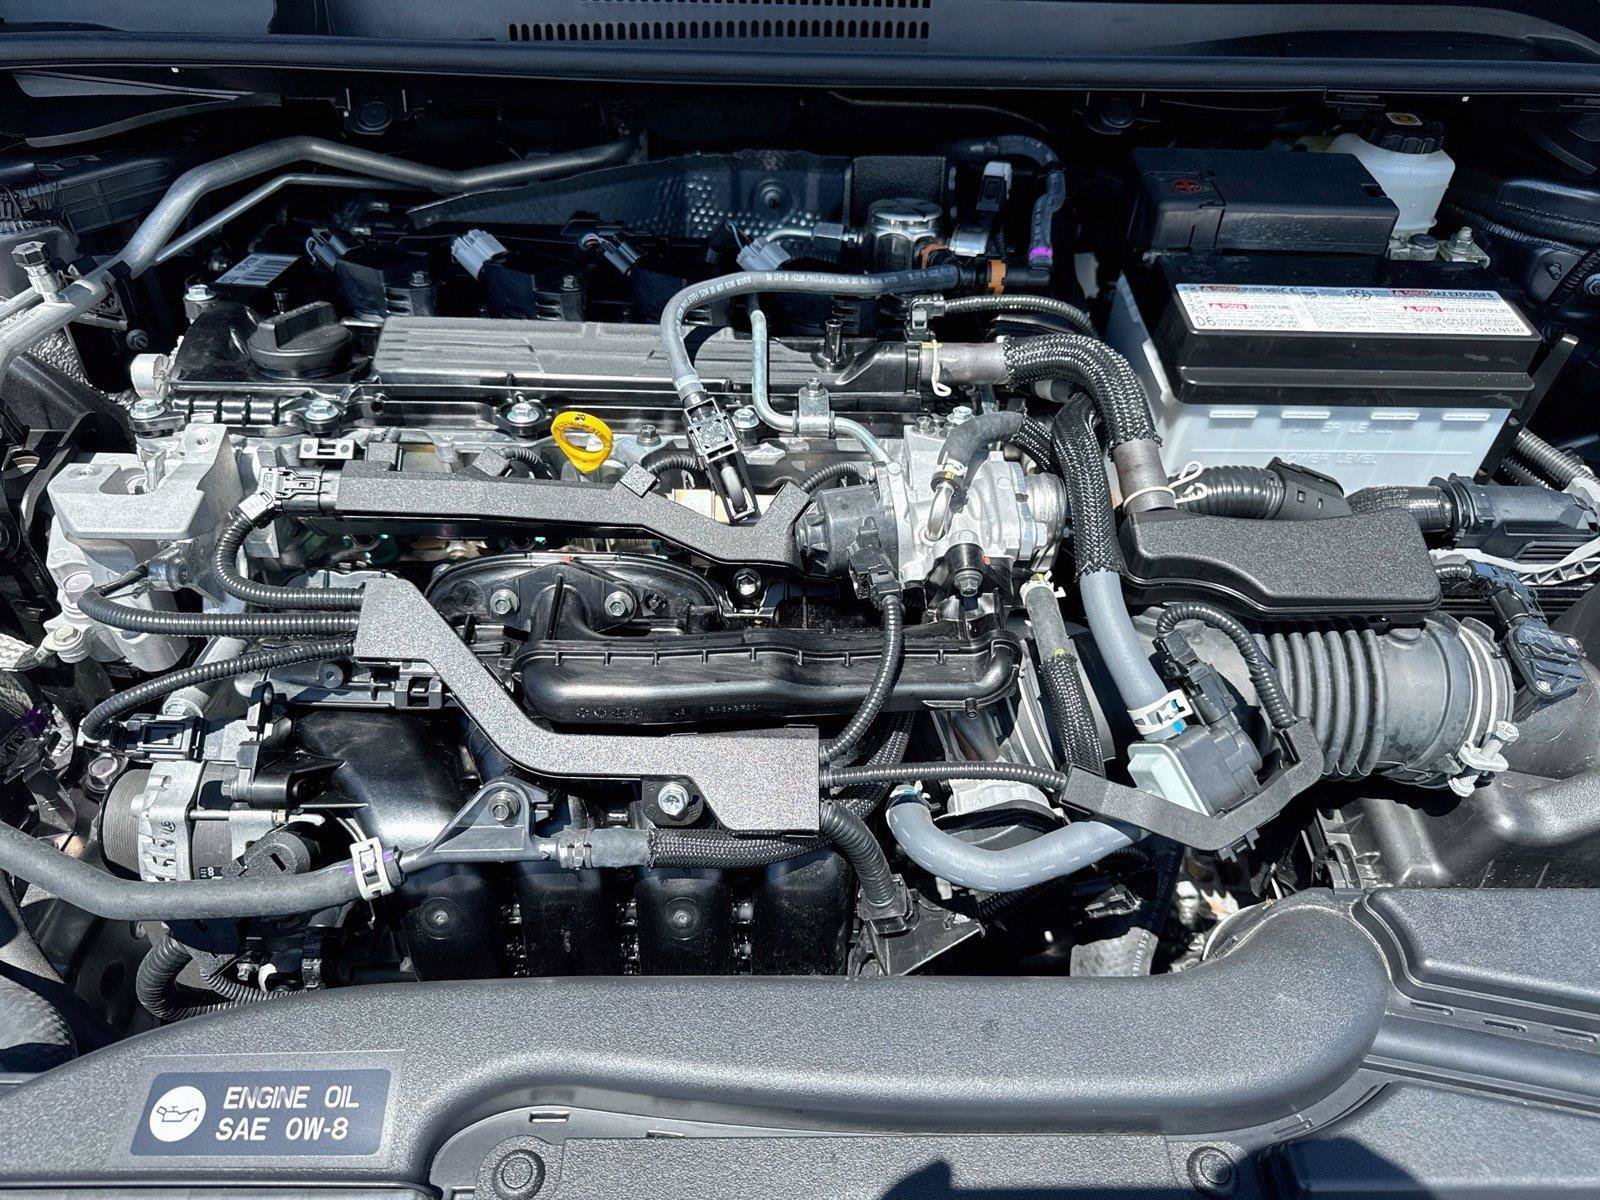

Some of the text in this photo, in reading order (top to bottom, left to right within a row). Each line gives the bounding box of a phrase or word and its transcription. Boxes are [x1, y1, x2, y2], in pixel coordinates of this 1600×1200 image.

[1336, 453, 1379, 464] LEVEL
[222, 1085, 360, 1110] ENGINE OIL
[215, 1117, 349, 1142] SAE 0W-8
